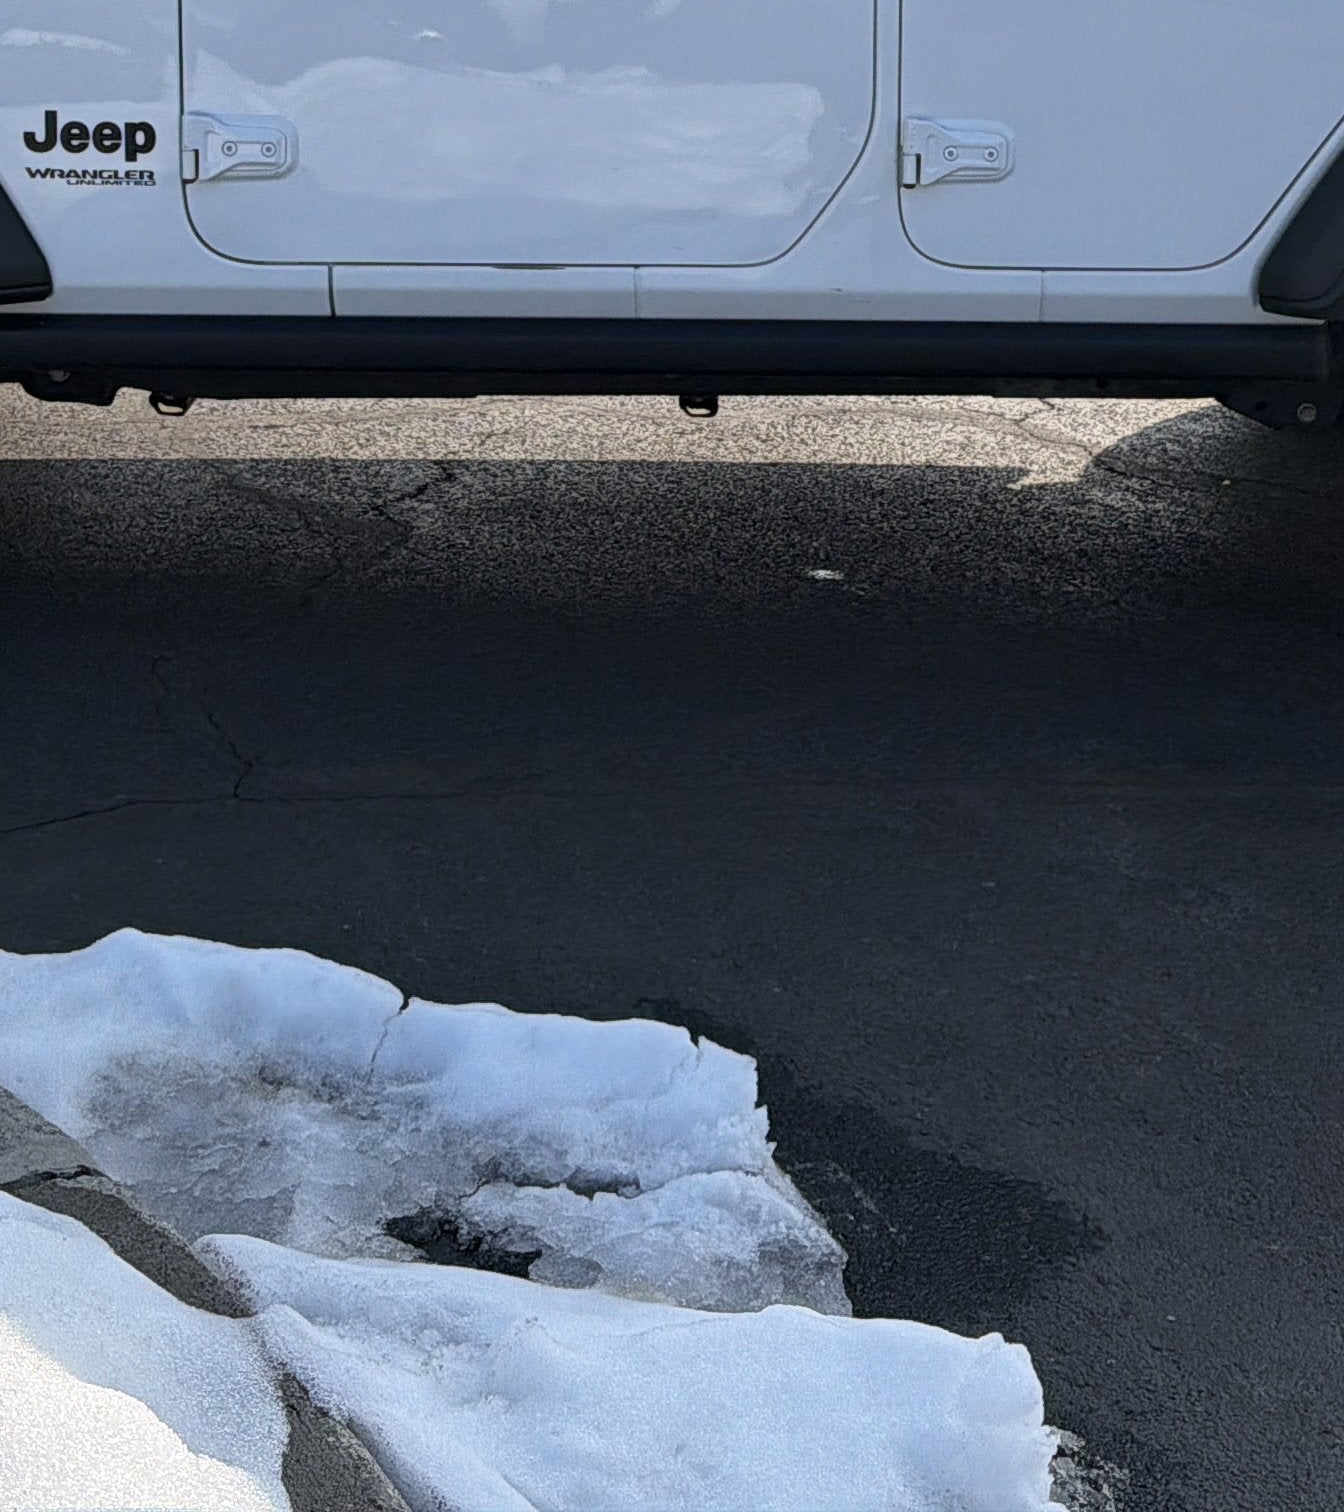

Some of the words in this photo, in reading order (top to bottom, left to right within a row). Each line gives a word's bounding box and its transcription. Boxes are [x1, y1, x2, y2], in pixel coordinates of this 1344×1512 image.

[23, 109, 156, 163] Jeep
[24, 166, 156, 181] WRANGLER
[66, 179, 157, 187] UNLIMITED
